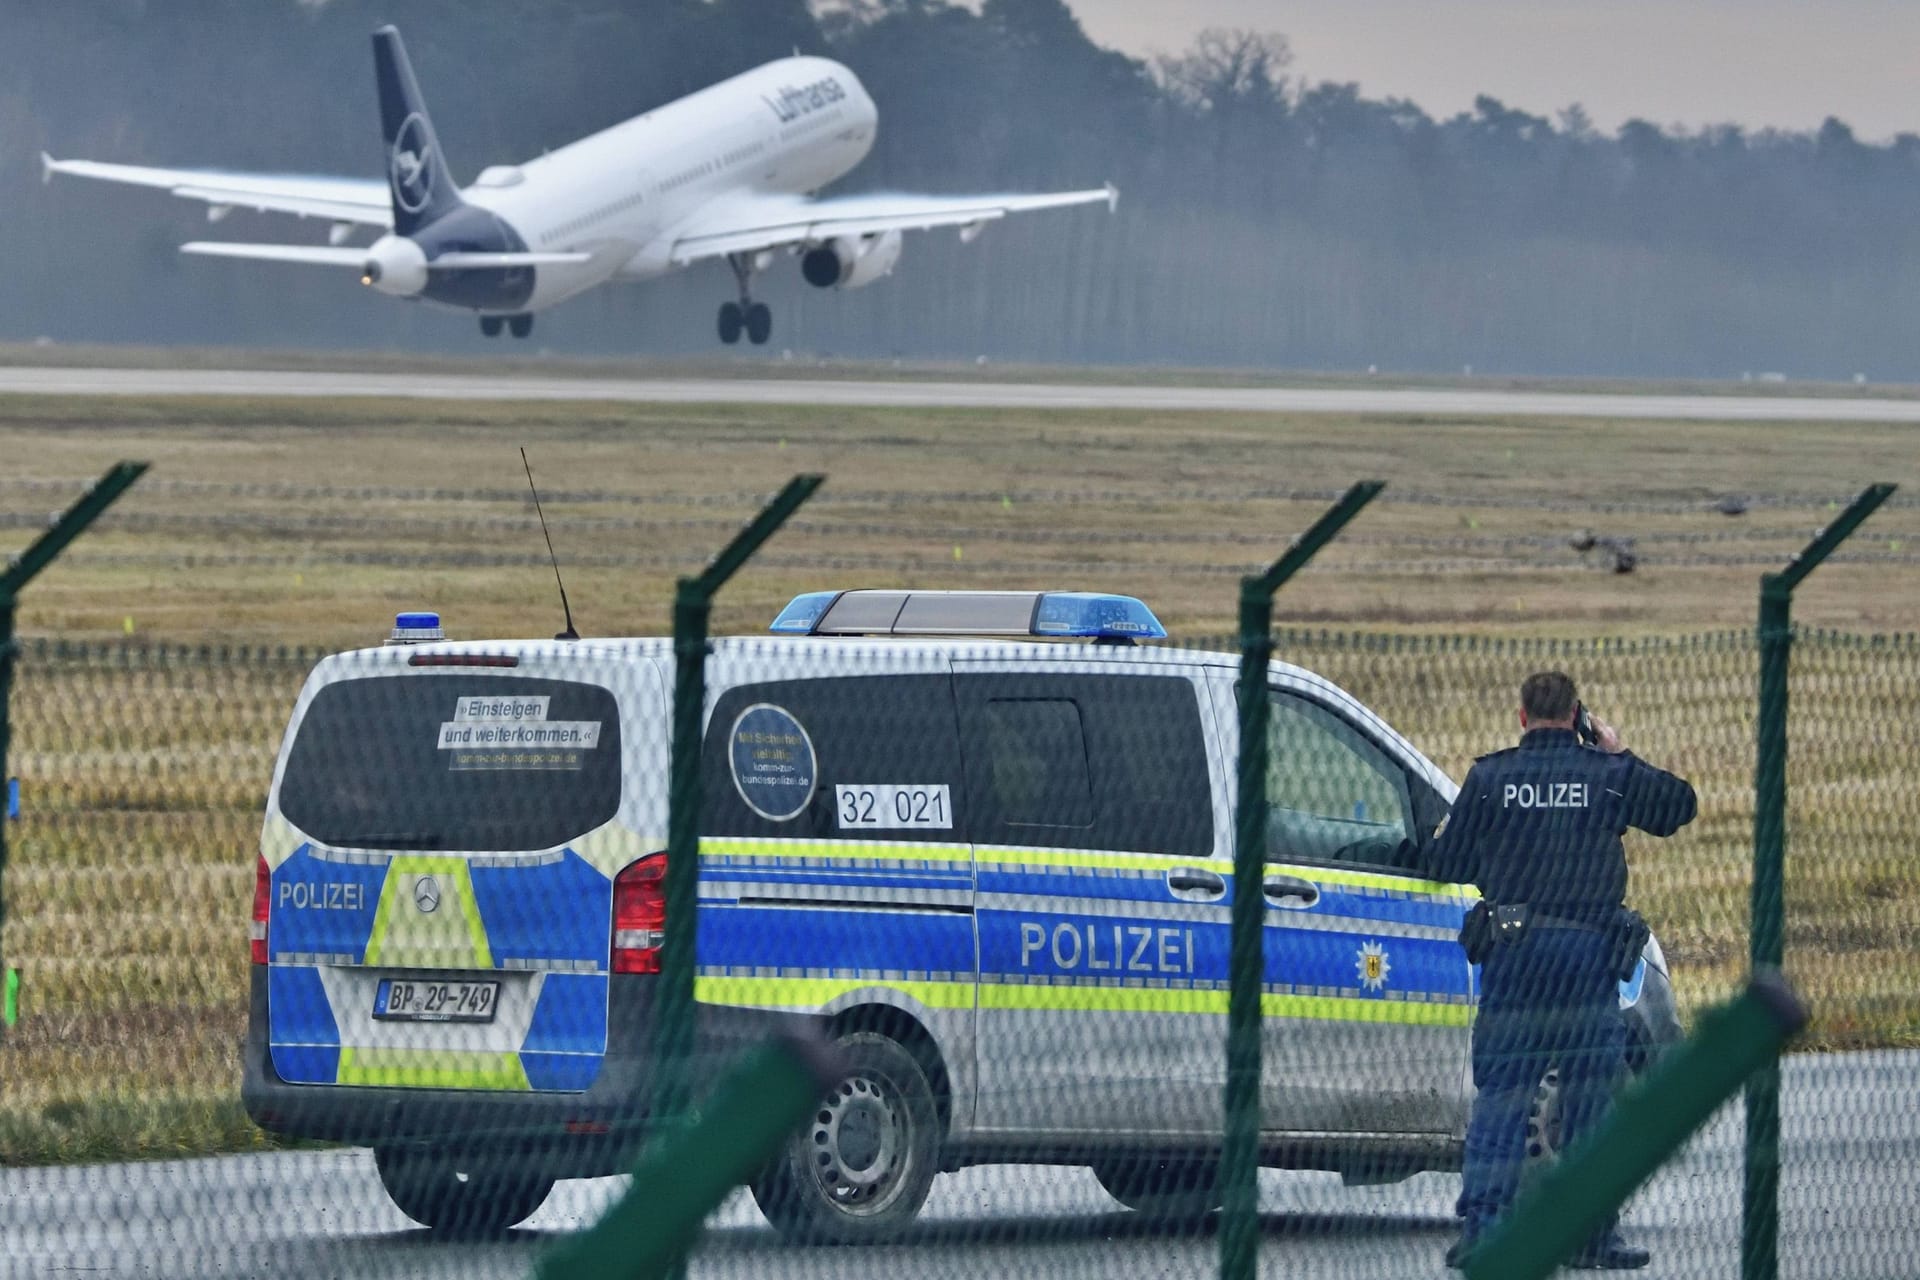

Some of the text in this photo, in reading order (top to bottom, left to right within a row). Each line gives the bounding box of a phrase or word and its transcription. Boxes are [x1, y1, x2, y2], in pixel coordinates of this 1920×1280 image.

[445, 728, 471, 742] und
[842, 791, 943, 822] 32 021
[1503, 783, 1588, 808] POLIZEI
[280, 882, 364, 909] POLIZEI
[1020, 922, 1194, 974] POLIZEI
[390, 985, 492, 1012] BP 29-749
